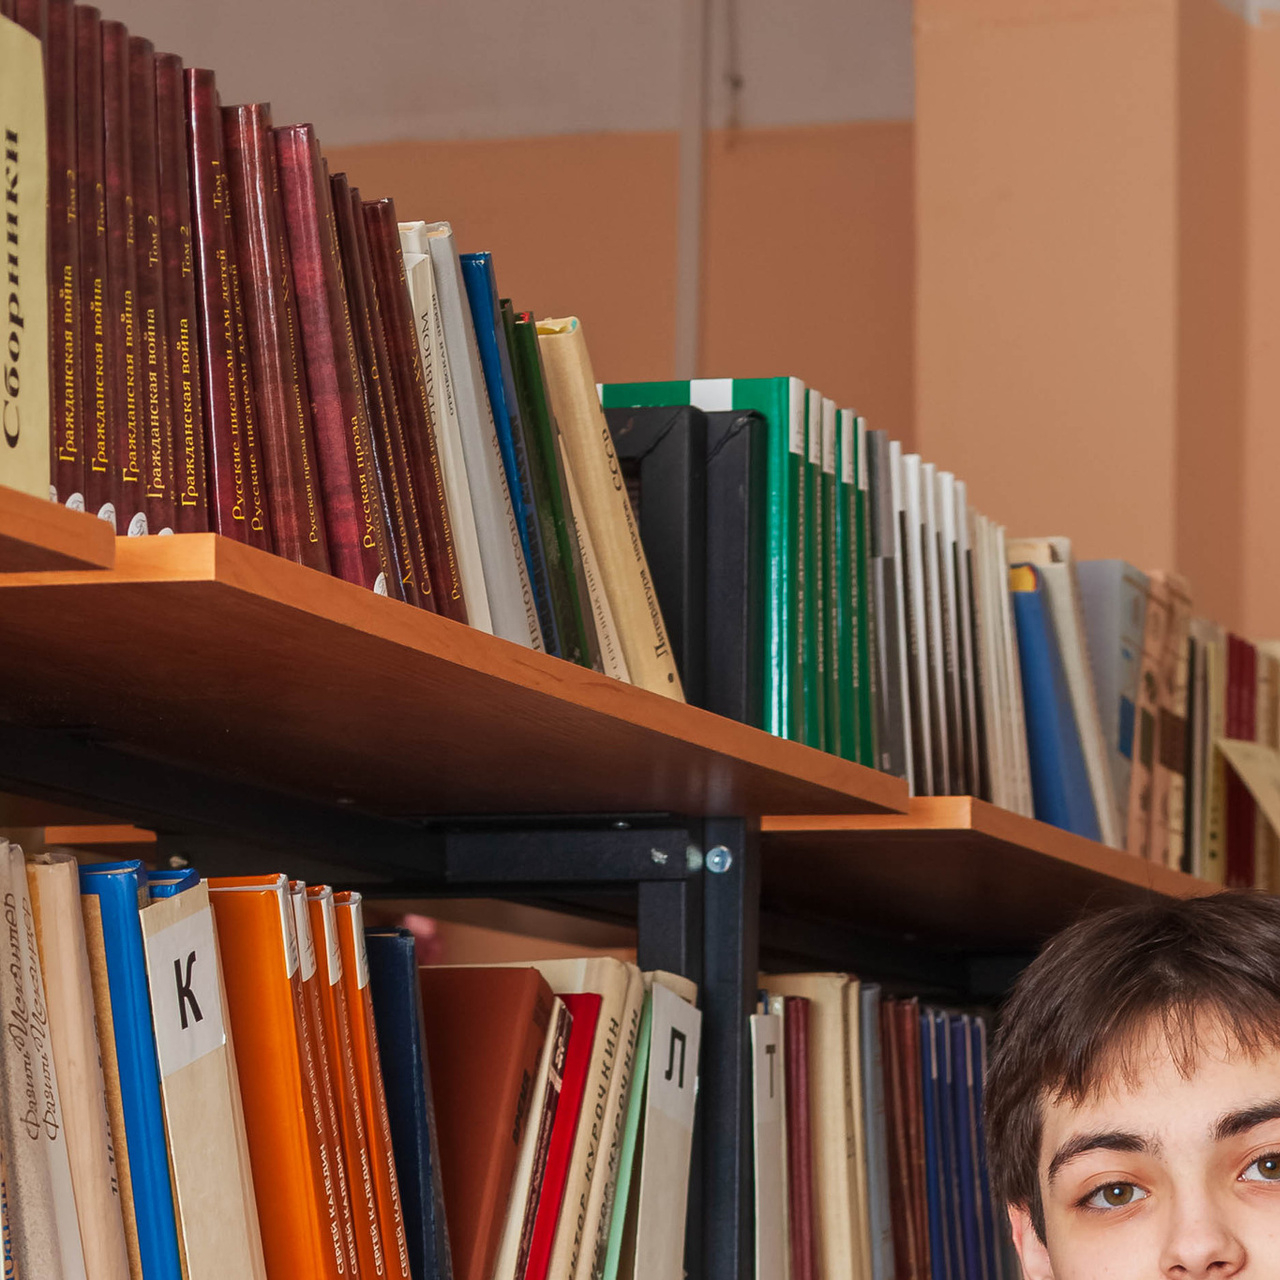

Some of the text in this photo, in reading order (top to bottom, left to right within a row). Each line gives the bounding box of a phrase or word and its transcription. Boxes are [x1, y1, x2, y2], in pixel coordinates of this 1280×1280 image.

[213, 174, 223, 209] Том
[3, 128, 25, 449] Сборники
[148, 232, 159, 268] Том
[180, 225, 191, 278] Том 2
[217, 249, 230, 302] детей
[59, 265, 77, 462] Гражданская война
[90, 278, 109, 472] Гражданская война
[120, 290, 140, 482] Гражданская война
[143, 308, 165, 498] Гражданская война
[226, 350, 239, 435] писатели
[240, 362, 255, 448] писатели
[176, 318, 198, 506] Гражданская война
[231, 441, 246, 520] Русские
[248, 454, 264, 531] Русские
[300, 442, 312, 482] проза
[350, 414, 378, 549] Русская проза
[601, 427, 623, 492] СССР
[303, 489, 319, 543] Русская
[389, 470, 415, 588] Литература
[439, 503, 451, 543] проза
[446, 546, 461, 601] Русская
[639, 569, 670, 659] Литература
[5, 892, 41, 1142] Фазиль Искандер
[175, 951, 204, 1030] К
[40, 1050, 60, 1142] Фазиль
[297, 987, 345, 1275] СЕРГЕЙ КАЛЕДИН ИЗБРАННАЯ ПРОЗА
[320, 1045, 338, 1137] ИЗБРАННАЯ
[584, 1016, 620, 1183] КУРОЧКИН
[605, 1008, 639, 1178] КУРОЧКИН
[335, 1145, 350, 1219] КАЛЕДИН
[345, 1048, 383, 1276] СЕРГЕЙ КАЛЕДИН ИЗБРАННАЯ
[386, 1150, 401, 1223] КАЛЕДИН
[344, 1221, 358, 1275] СЕРГЕЙ
[395, 1225, 409, 1278] СЕРГЕЙ
